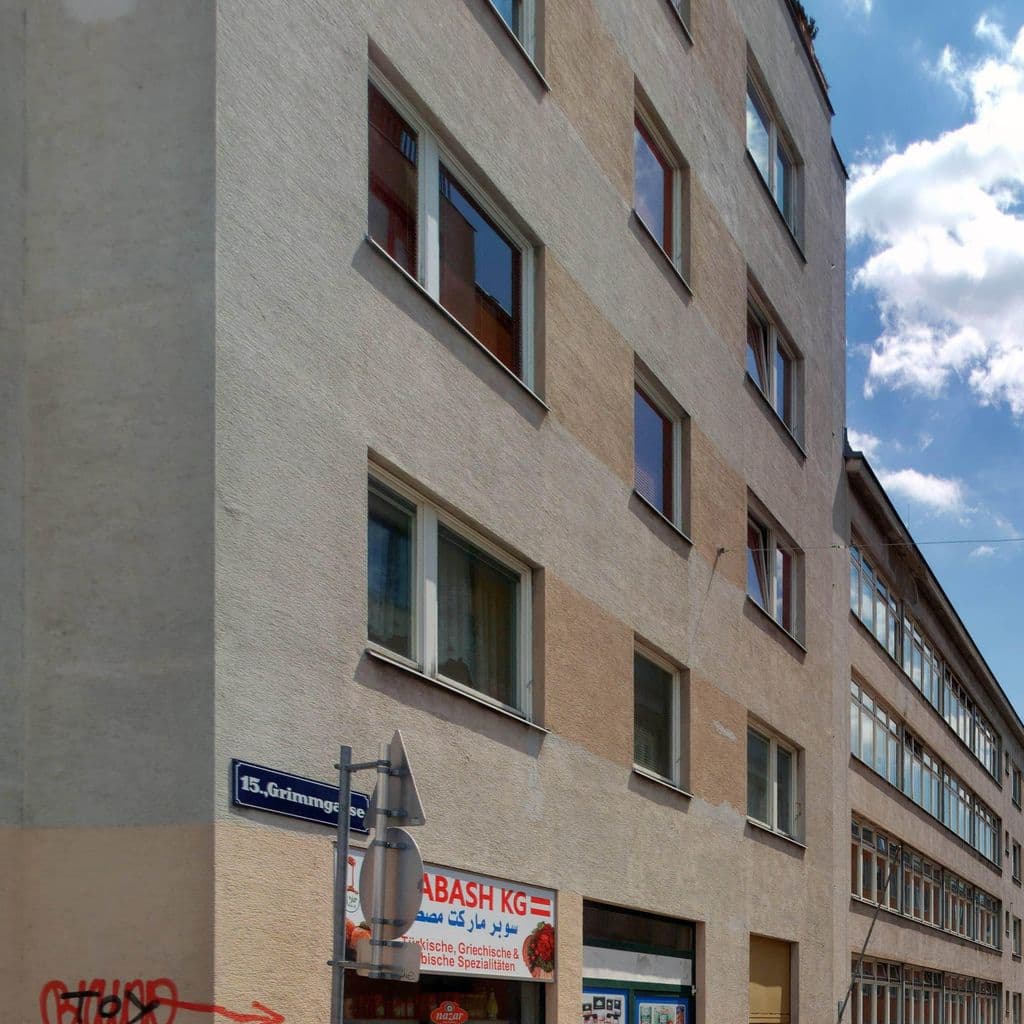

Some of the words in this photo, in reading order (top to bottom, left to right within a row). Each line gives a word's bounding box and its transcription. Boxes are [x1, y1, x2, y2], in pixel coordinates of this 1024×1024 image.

[240, 775, 365, 818] 15.,Grimmgase
[423, 873, 494, 911] ABASH
[501, 887, 527, 916] KG
[420, 952, 455, 967] bische
[457, 955, 515, 972] Spezialitäten
[458, 942, 512, 959] Griechische
[513, 948, 520, 960] &
